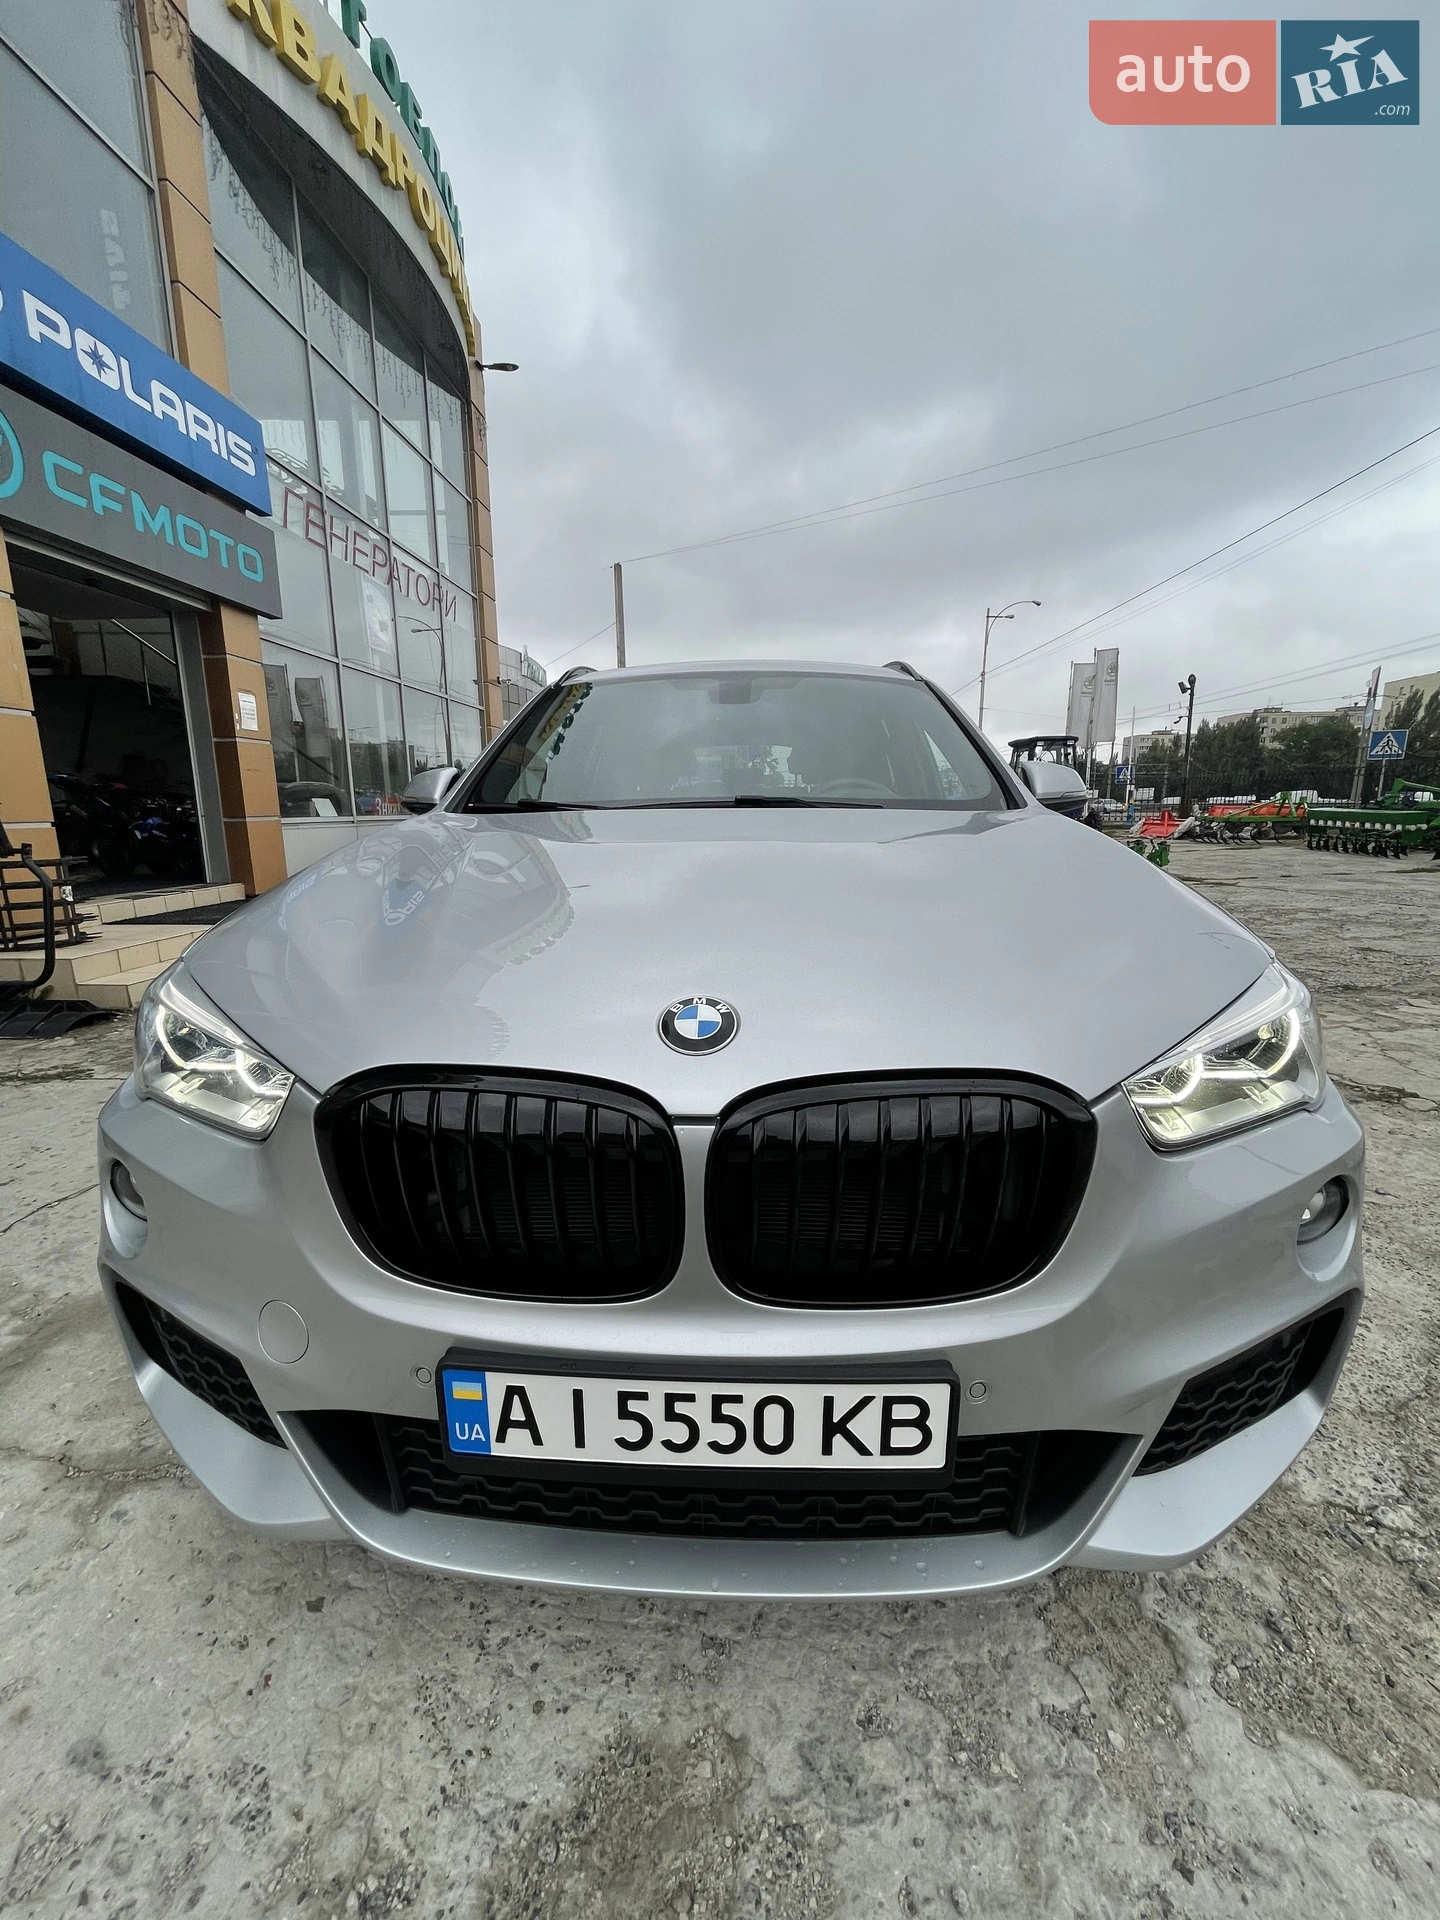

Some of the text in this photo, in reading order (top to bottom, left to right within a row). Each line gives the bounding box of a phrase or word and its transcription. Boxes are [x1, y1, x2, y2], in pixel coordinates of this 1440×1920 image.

[23, 290, 256, 477] POLARIS
[42, 450, 264, 583] CFMOTO
[283, 486, 457, 623] ГЕНЕРАТОРИ
[669, 997, 731, 1014] BMW
[455, 1422, 486, 1442] UA
[613, 1389, 795, 1456] 5550
[821, 1395, 933, 1457] KB
